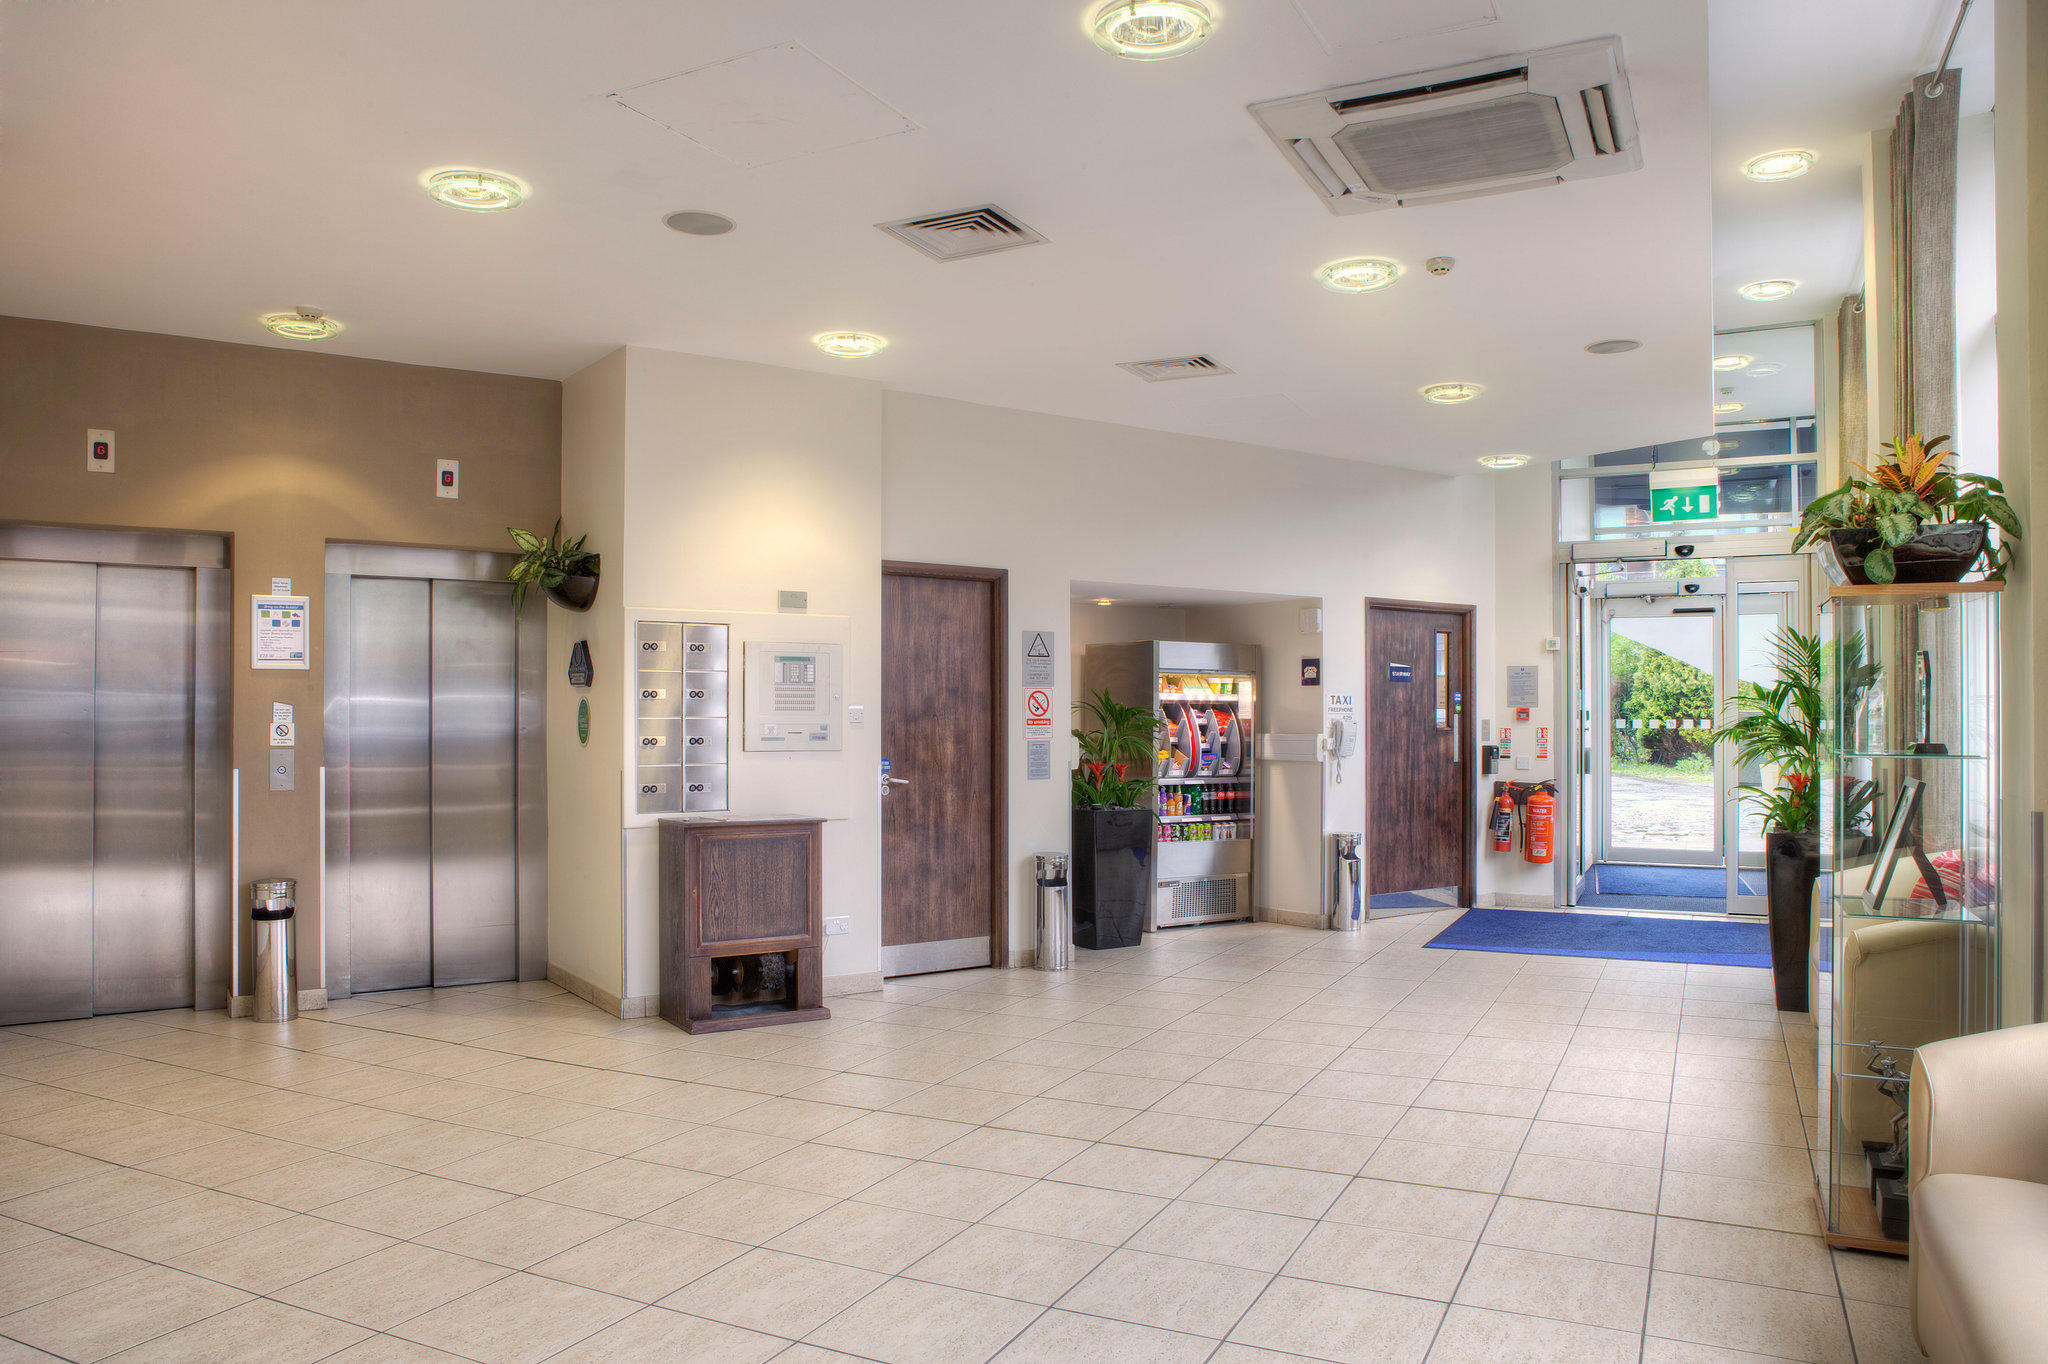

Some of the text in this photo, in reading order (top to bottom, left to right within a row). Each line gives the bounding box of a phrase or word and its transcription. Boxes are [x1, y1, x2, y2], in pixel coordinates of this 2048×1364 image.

[97, 445, 105, 455] G
[444, 473, 451, 482] G
[1330, 695, 1352, 705] TAXI
